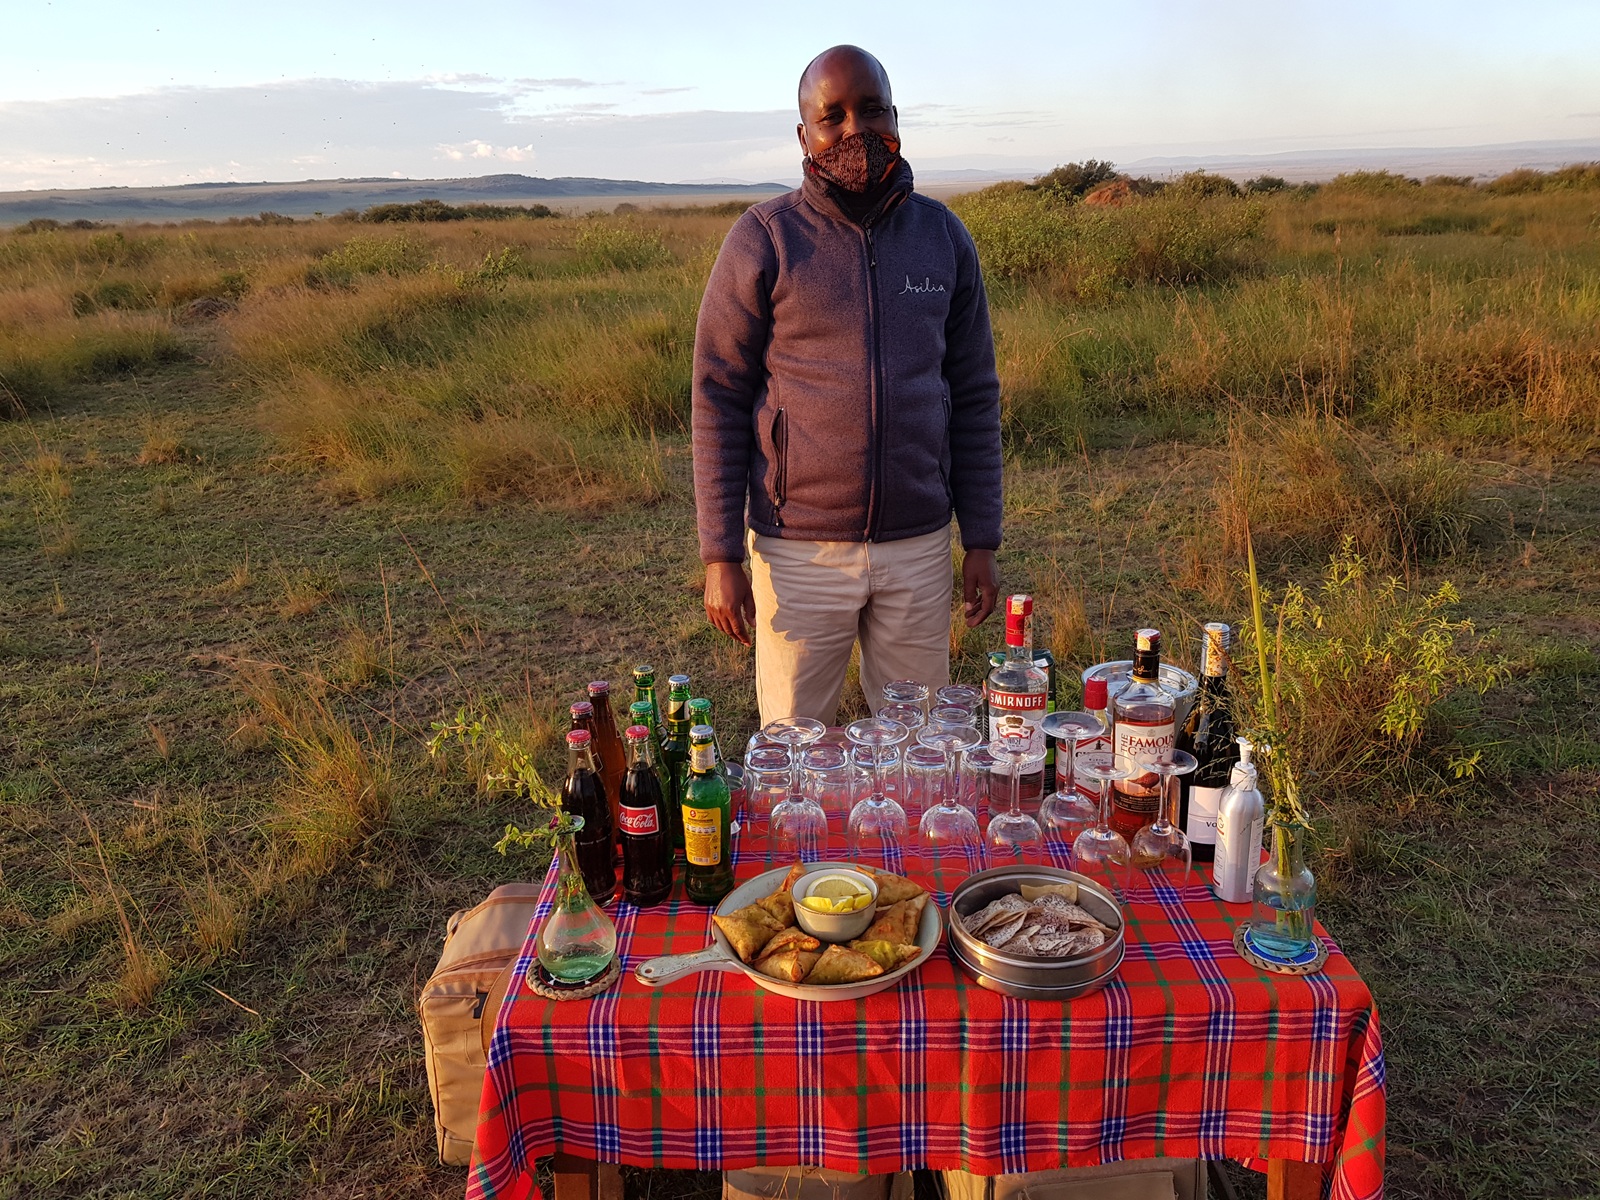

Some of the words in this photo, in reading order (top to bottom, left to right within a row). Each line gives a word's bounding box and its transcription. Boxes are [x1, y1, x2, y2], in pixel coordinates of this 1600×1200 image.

[899, 274, 946, 295] Asilia
[990, 692, 1044, 708] SMIRNOFF
[1129, 733, 1174, 748] FAMOUS
[1128, 744, 1172, 756] GROU
[620, 812, 654, 828] Coca-Cola
